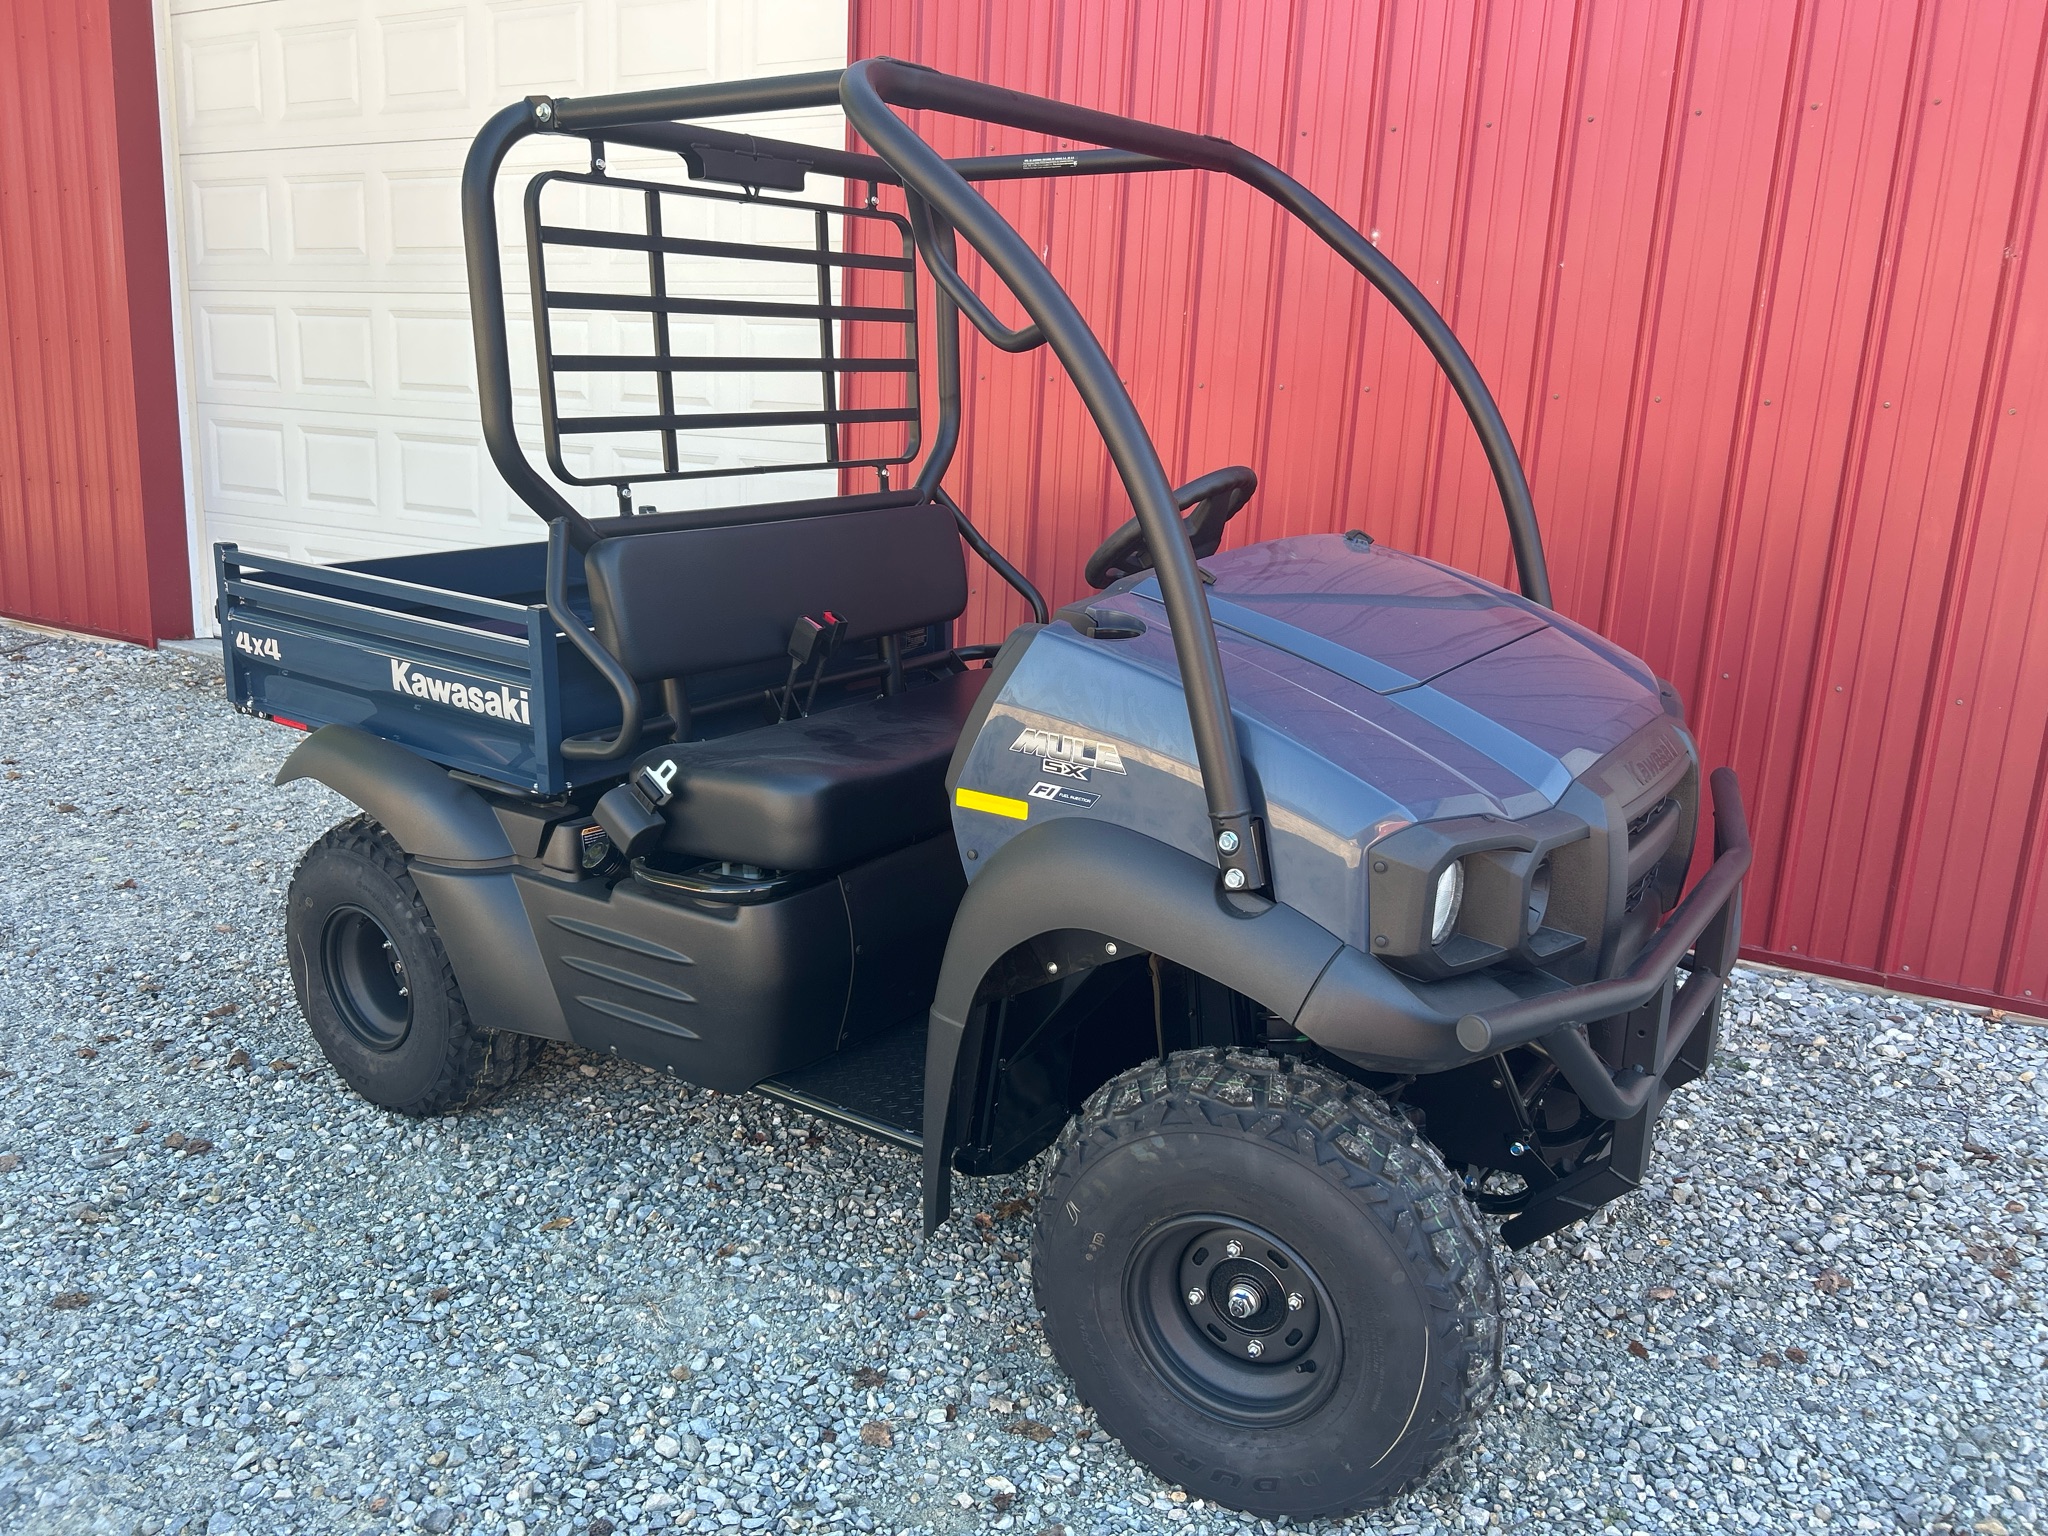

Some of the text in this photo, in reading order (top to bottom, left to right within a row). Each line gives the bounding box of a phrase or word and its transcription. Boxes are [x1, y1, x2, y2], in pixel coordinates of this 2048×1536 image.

[236, 631, 281, 661] 4x4
[390, 659, 531, 725] Kawasaki
[1009, 728, 1127, 776] MULE
[1042, 759, 1088, 781] SX
[1624, 733, 1679, 786] Kawasaki
[1033, 785, 1056, 797] FI
[1139, 1426, 1282, 1494] DURO
